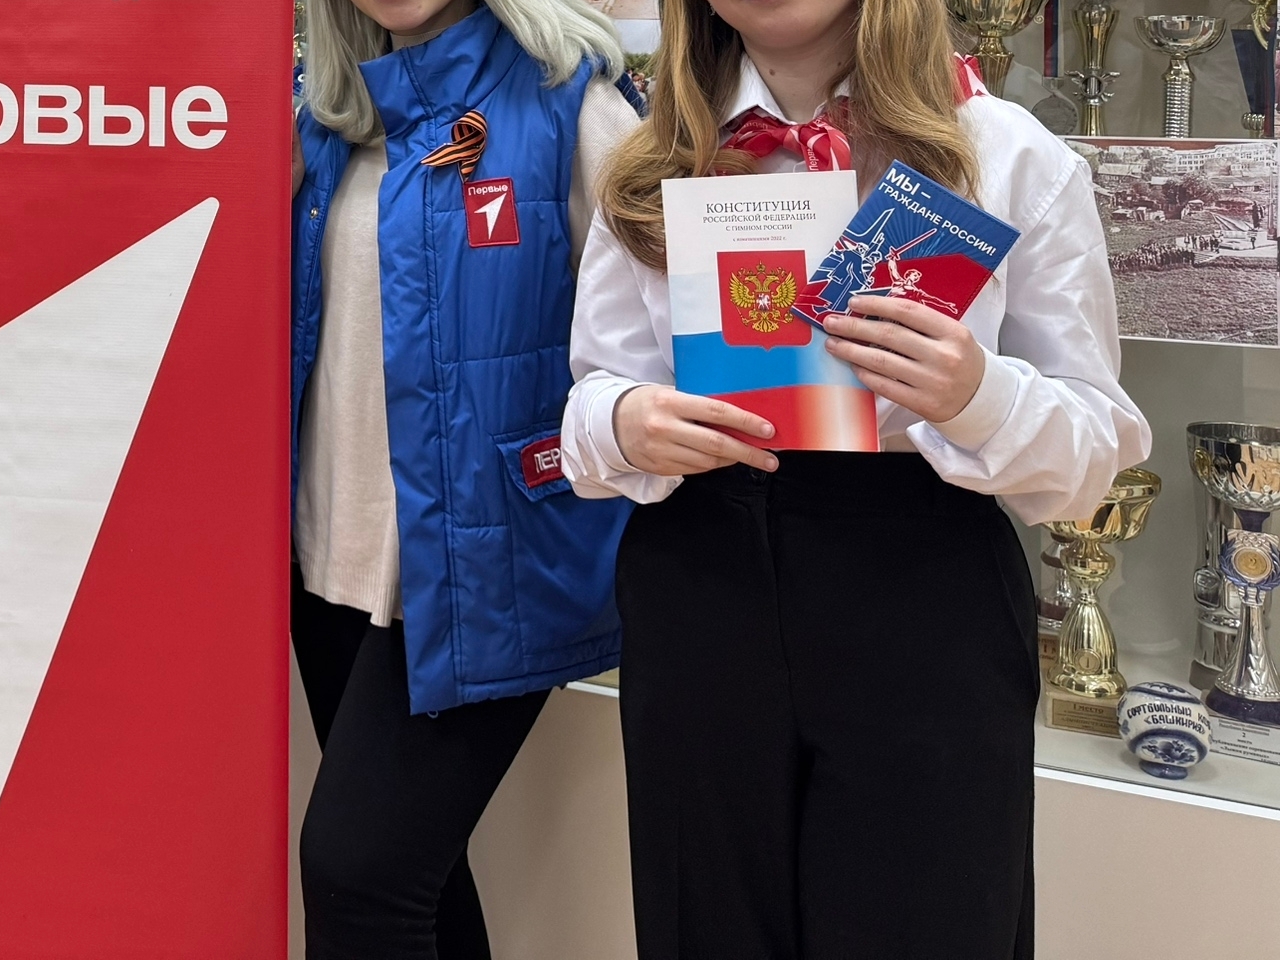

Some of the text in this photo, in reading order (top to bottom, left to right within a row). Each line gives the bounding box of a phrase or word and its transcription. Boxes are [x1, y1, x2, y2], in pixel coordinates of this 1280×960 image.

[885, 167, 920, 196] МЫ
[467, 184, 509, 197] Первые
[705, 199, 812, 214] КОНСТИТУЦИЯ
[702, 212, 817, 224] РОССИЙСКОЙ ФЕДЕРАЦИИ
[878, 181, 997, 256] ГРАЖДАНЕ РОССИИ!
[731, 224, 762, 232] ГИМНОМ
[763, 223, 793, 231] РОССИИ
[533, 447, 561, 474] ПЕР
[1126, 703, 1193, 720] СОФТБОЛЬНЫЙ
